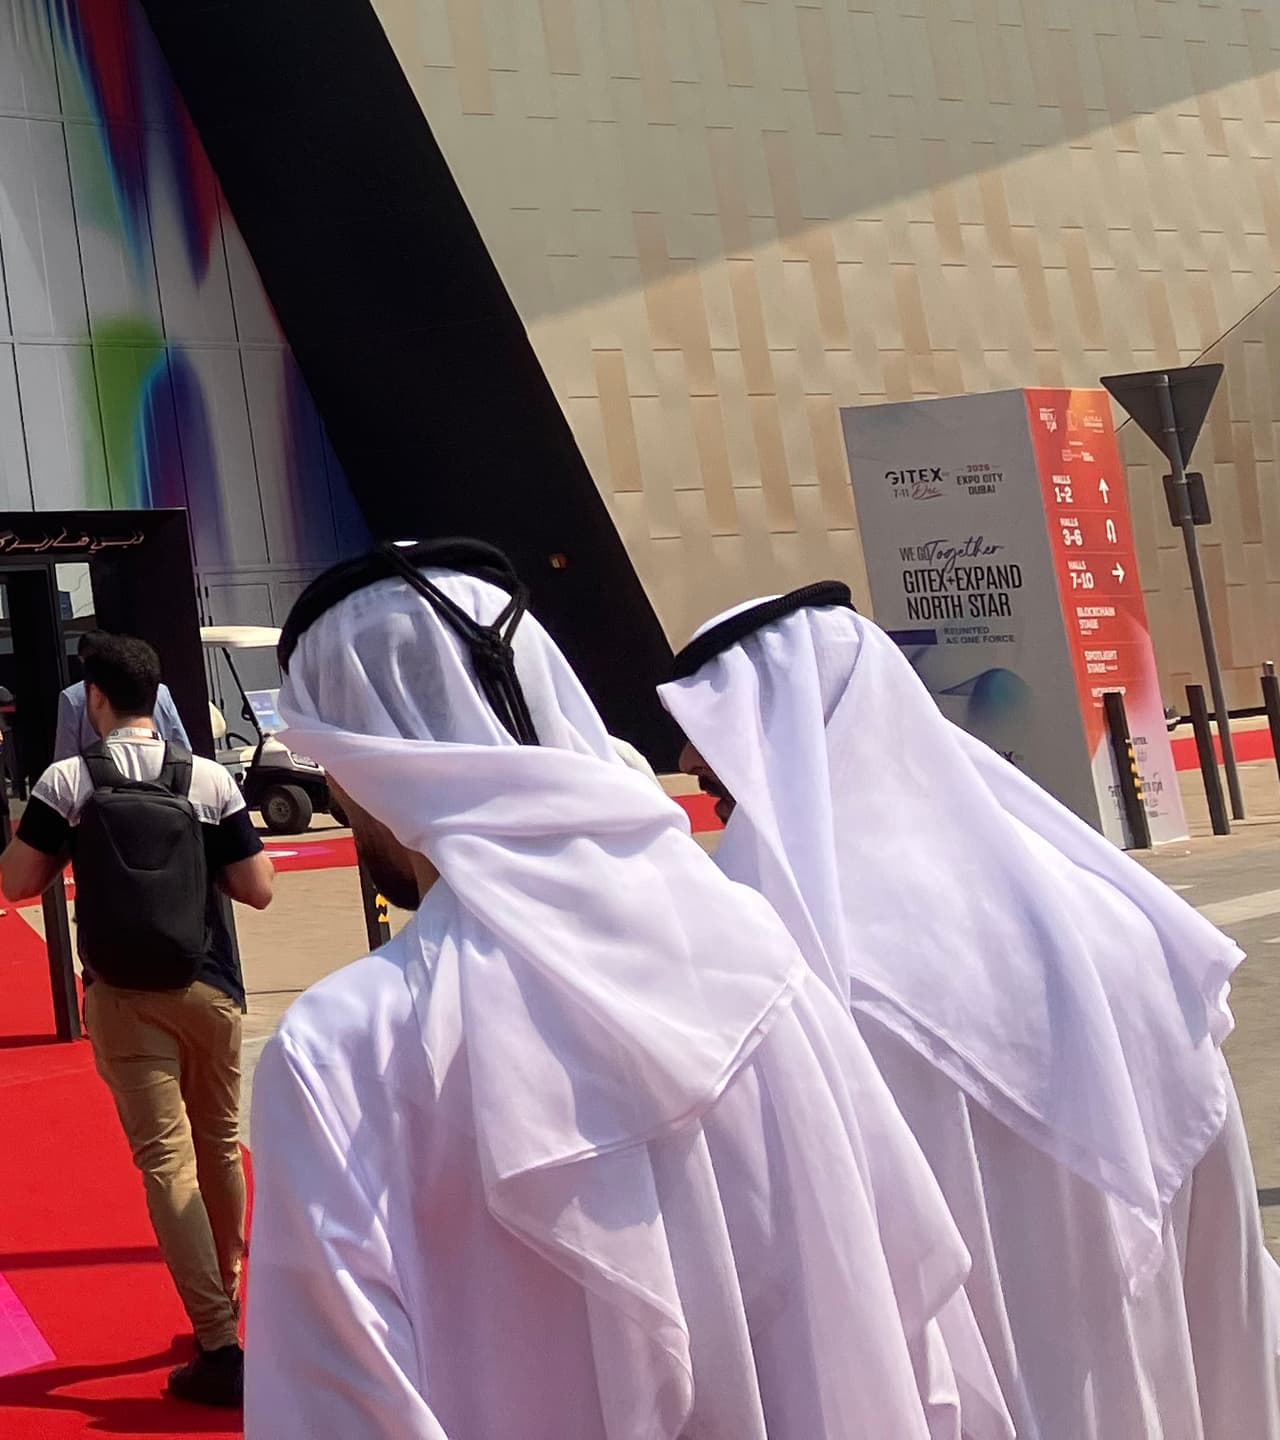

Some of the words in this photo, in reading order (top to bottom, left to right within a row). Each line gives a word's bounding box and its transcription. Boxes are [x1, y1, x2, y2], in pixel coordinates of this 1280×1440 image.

[884, 467, 944, 485] GITEX
[1054, 486, 1074, 503] 1-2
[1062, 528, 1083, 546] 3-6
[924, 535, 1004, 574] Together
[1069, 572, 1094, 589] 7-10
[906, 594, 964, 621] NORTH
[968, 592, 1012, 618] STAR
